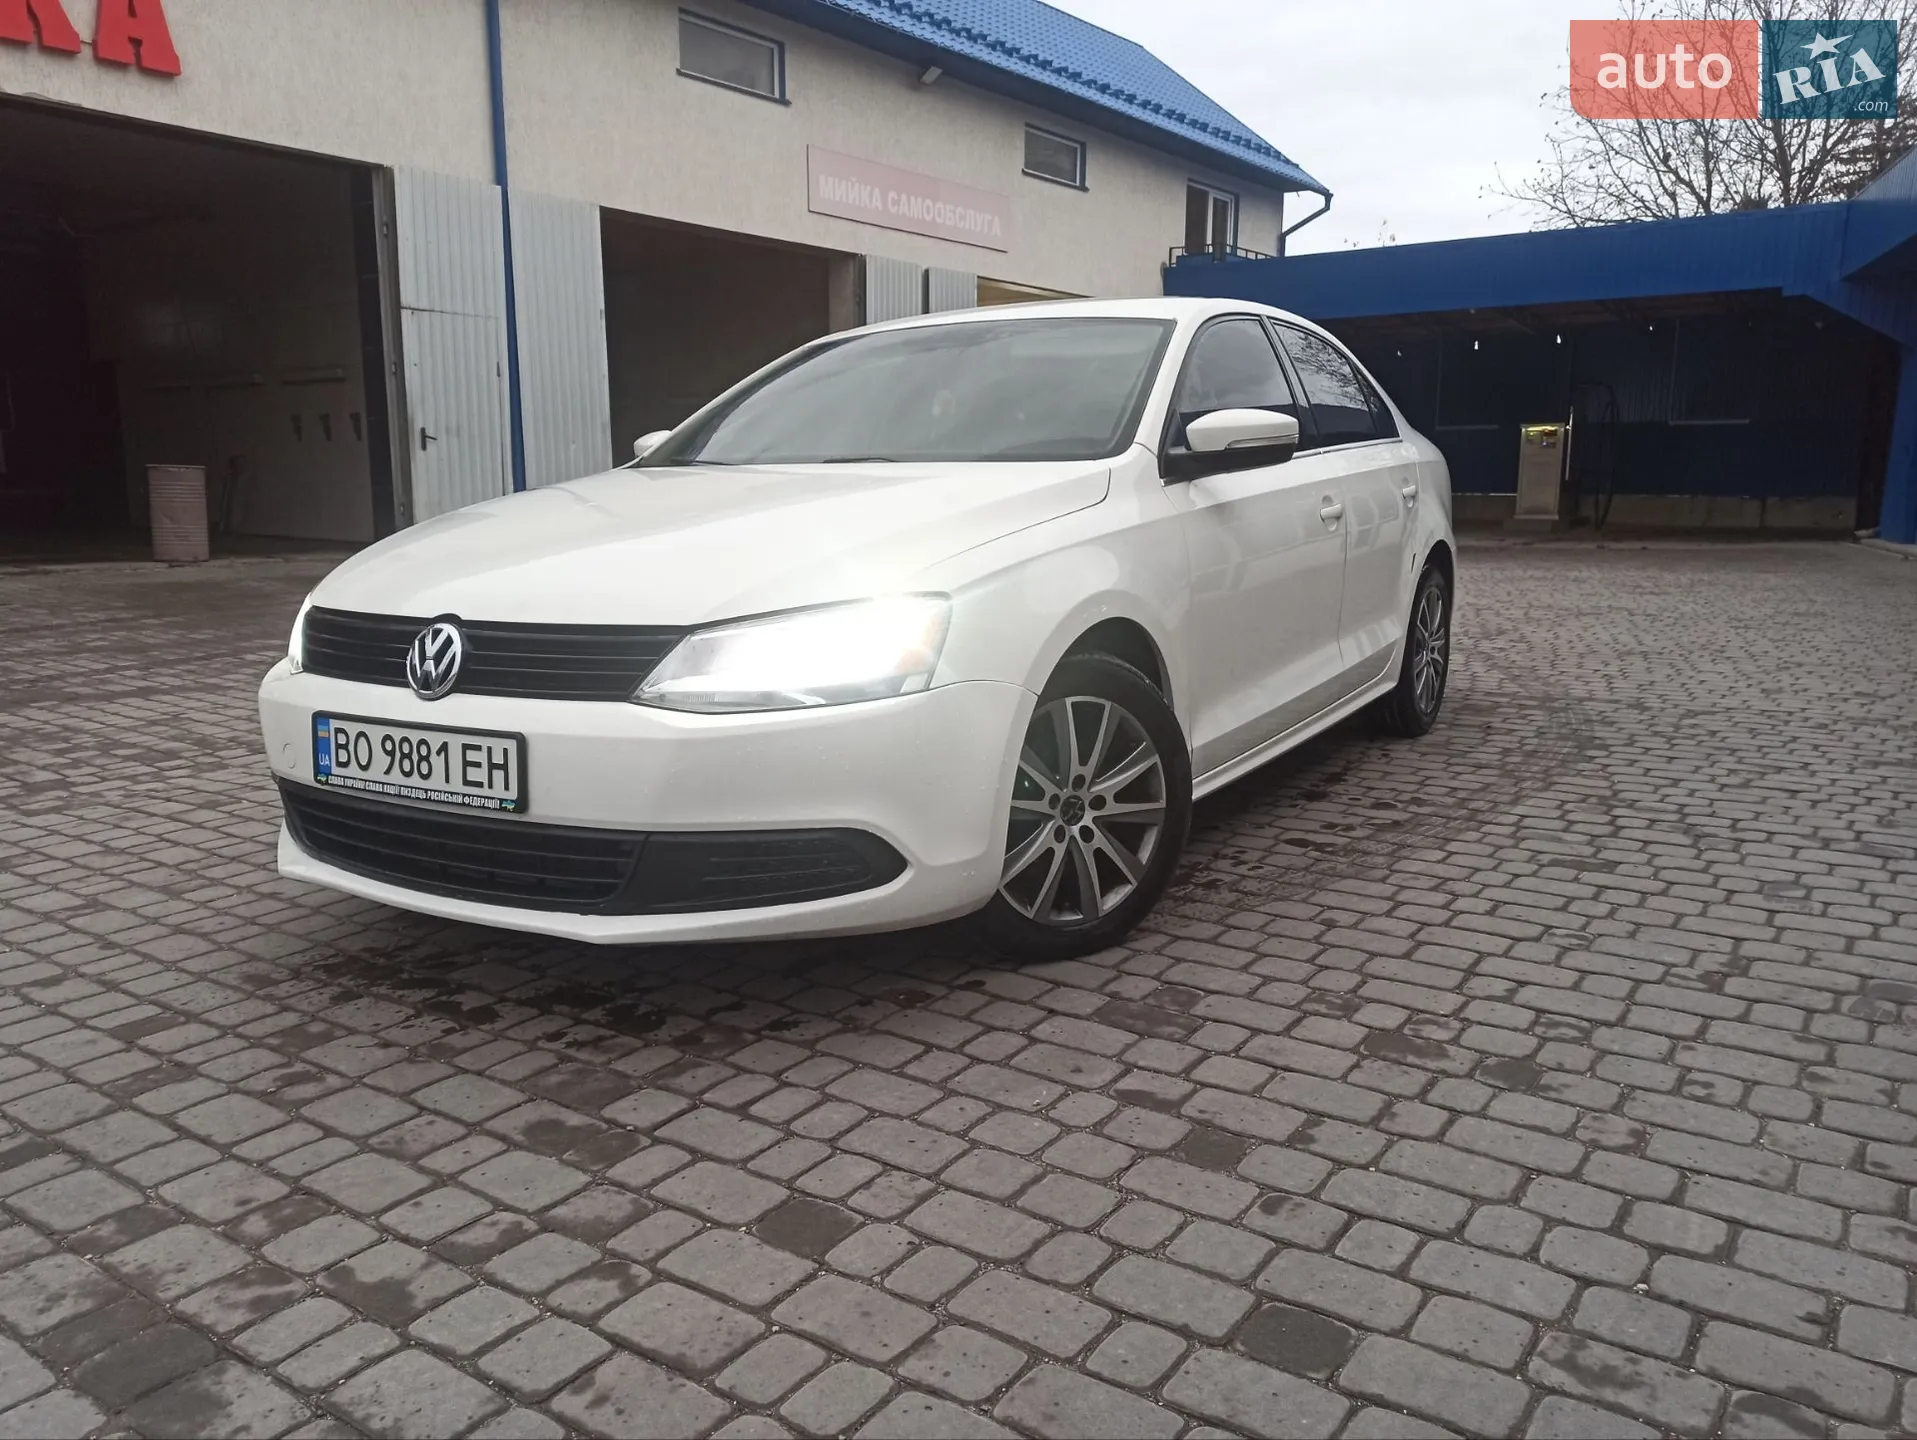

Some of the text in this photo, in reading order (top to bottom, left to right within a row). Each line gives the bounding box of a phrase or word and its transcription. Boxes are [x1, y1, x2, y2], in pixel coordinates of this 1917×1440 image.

[818, 175, 1001, 236] МИЙКА САМООБСЛУГА
[318, 753, 331, 767] UA
[381, 733, 450, 784] 9881
